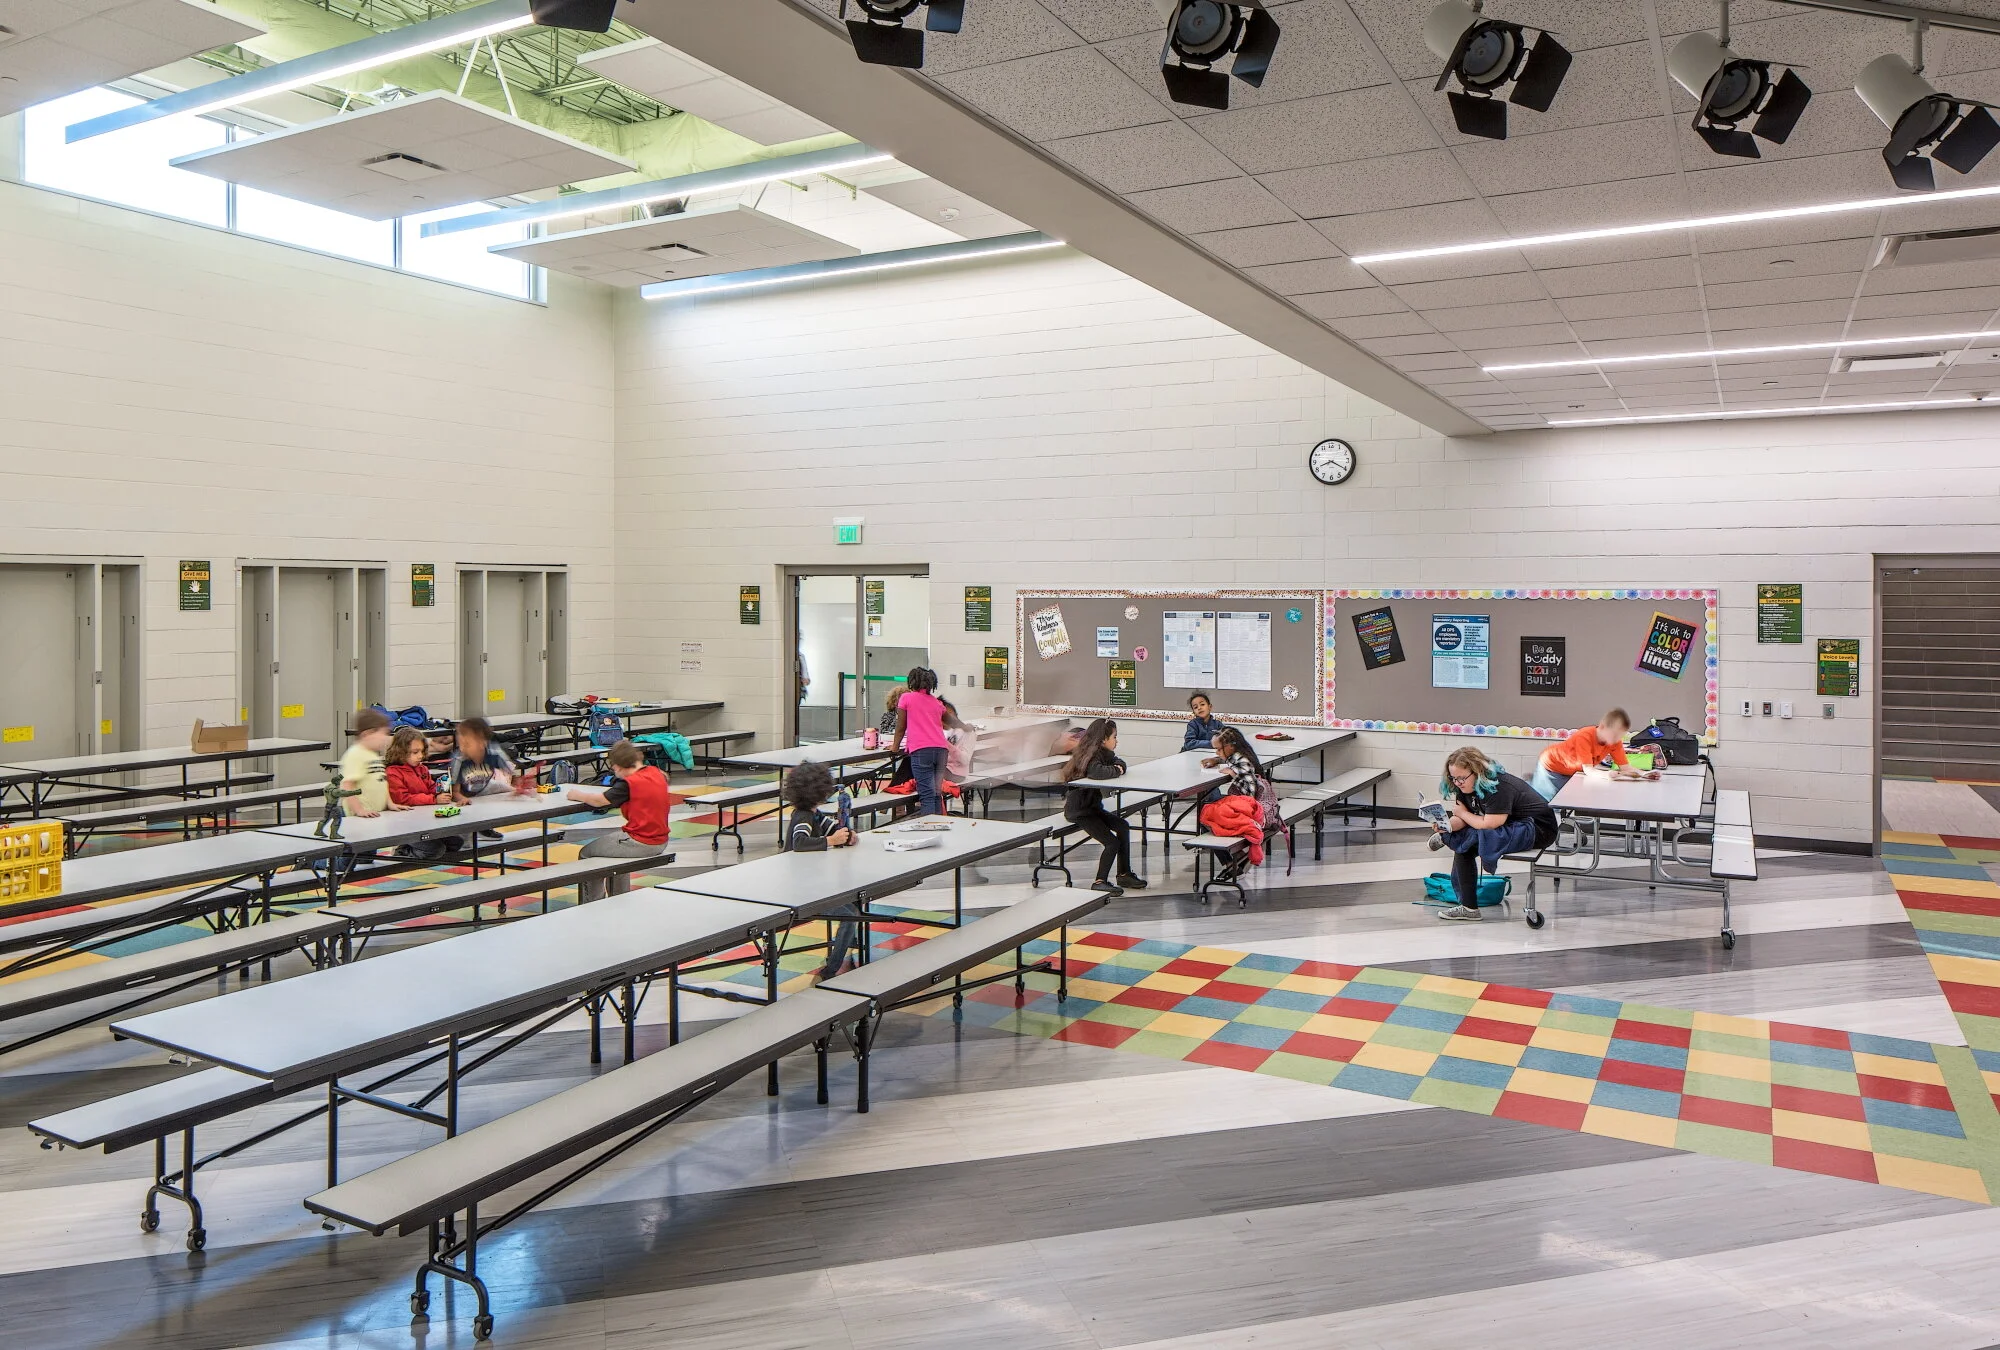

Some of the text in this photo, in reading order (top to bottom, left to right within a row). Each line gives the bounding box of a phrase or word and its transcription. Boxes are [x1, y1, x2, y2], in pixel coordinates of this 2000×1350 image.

[840, 526, 857, 542] EXIT
[1655, 621, 1691, 639] It's ok to
[1532, 645, 1544, 654] Be
[1650, 631, 1689, 653] COLOR
[1525, 653, 1562, 666] buddy
[1642, 650, 1680, 672] lines
[1527, 666, 1549, 674] NOT
